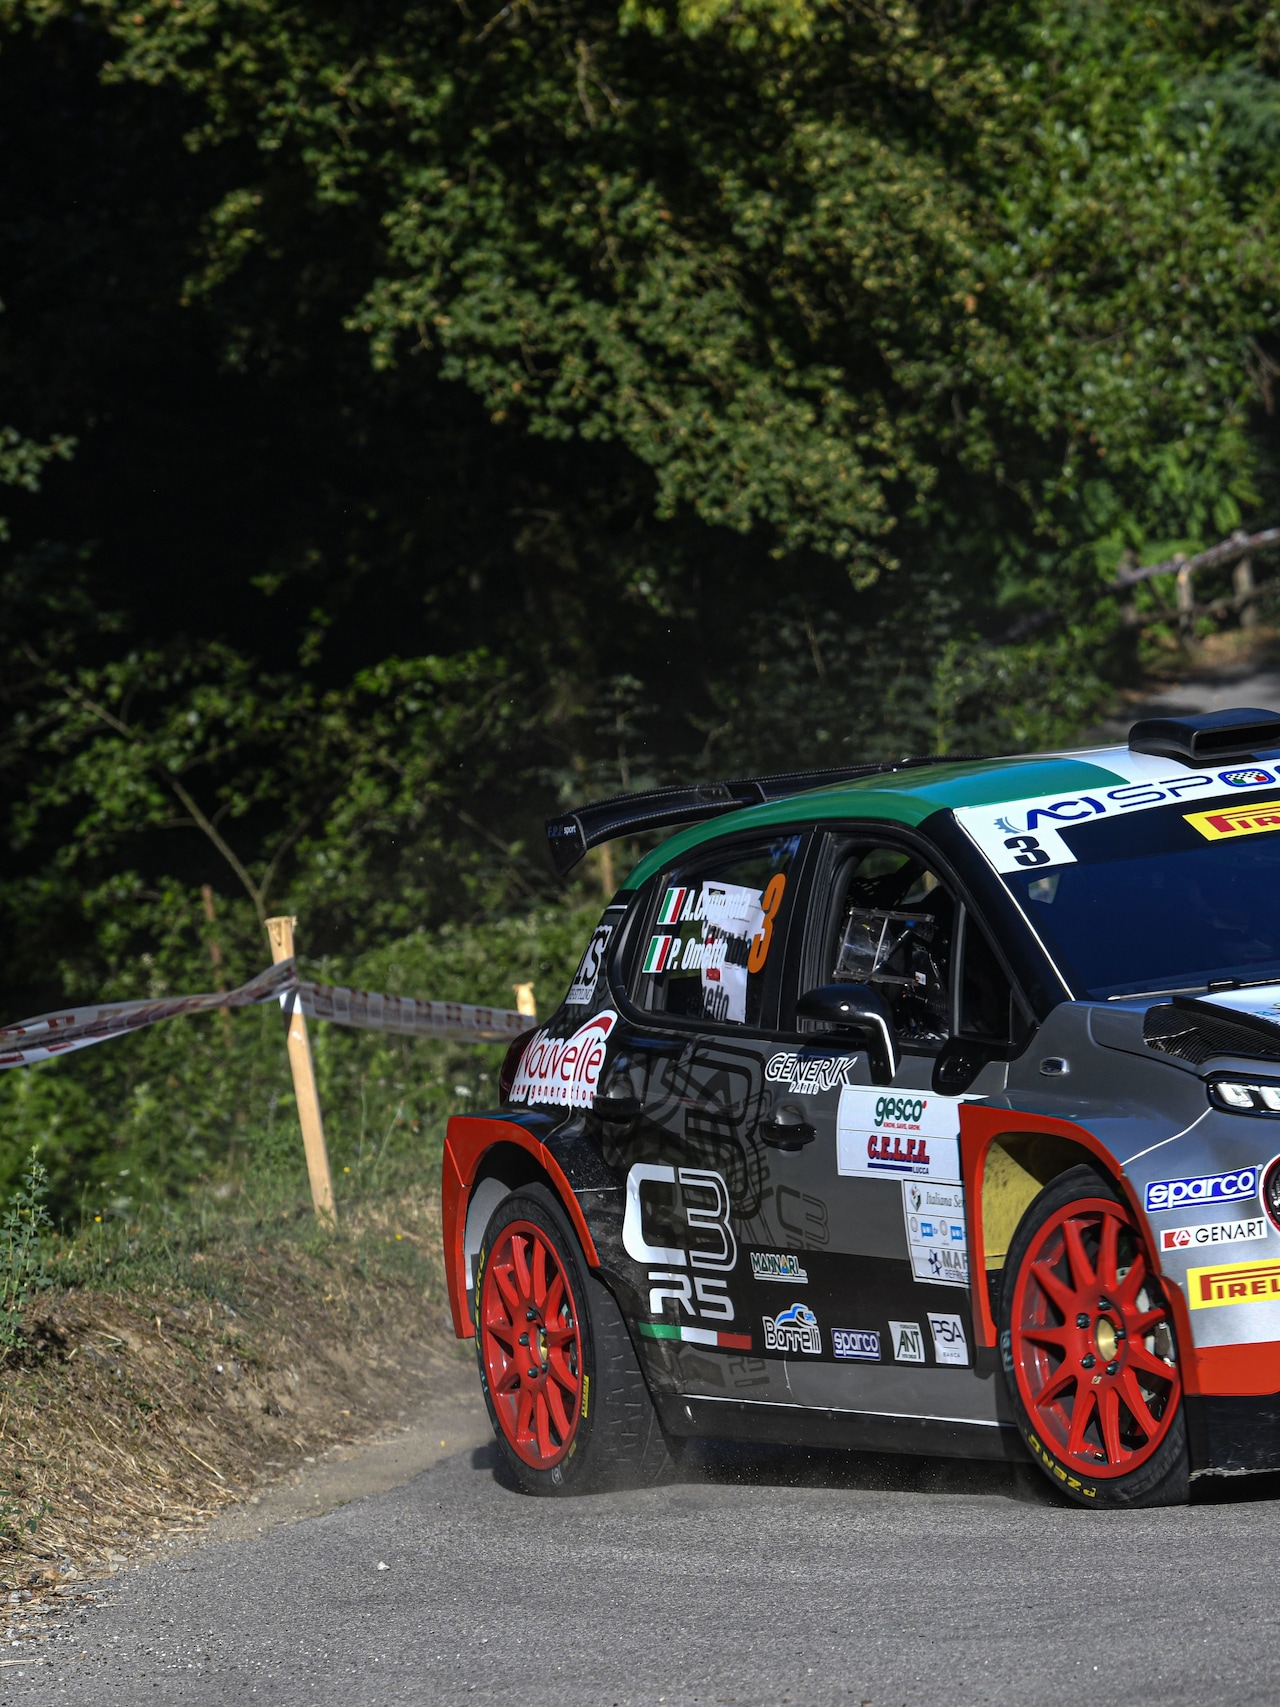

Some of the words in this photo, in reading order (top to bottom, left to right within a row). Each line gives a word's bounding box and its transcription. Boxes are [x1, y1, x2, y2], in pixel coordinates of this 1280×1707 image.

[1004, 835, 1051, 867] 3
[747, 873, 786, 974] 3
[516, 1035, 602, 1084] Nouvelle
[766, 1052, 859, 1092] GENERIK
[874, 1096, 922, 1127] gesco
[1149, 1172, 1254, 1208] sparco
[623, 1163, 737, 1271] C3
[1195, 1220, 1264, 1244] GENART
[751, 1253, 799, 1276] MANNARI
[648, 1271, 734, 1320] R5
[763, 1316, 822, 1354] Borrelli
[833, 1331, 878, 1355] sparco
[896, 1330, 921, 1359] ANT
[931, 1320, 964, 1343] PSA
